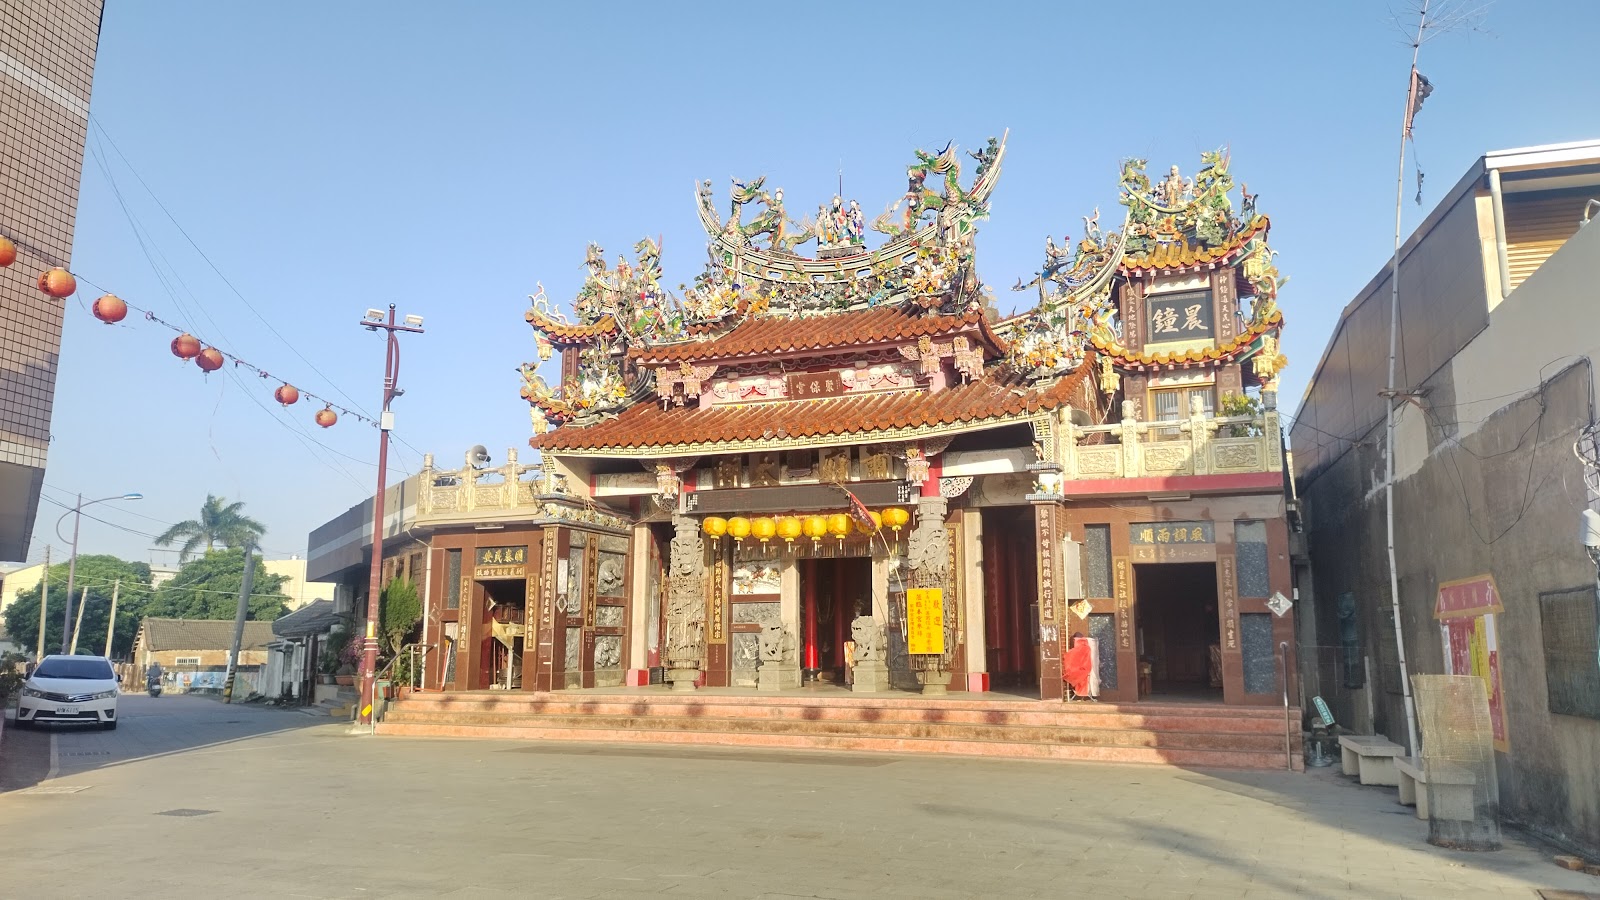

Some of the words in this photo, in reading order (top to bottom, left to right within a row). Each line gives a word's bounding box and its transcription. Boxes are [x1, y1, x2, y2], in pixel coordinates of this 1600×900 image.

[1152, 304, 1208, 333] 晨鐘
[1140, 527, 1205, 543] 風調雨順
[482, 548, 524, 564] 國泰民安
